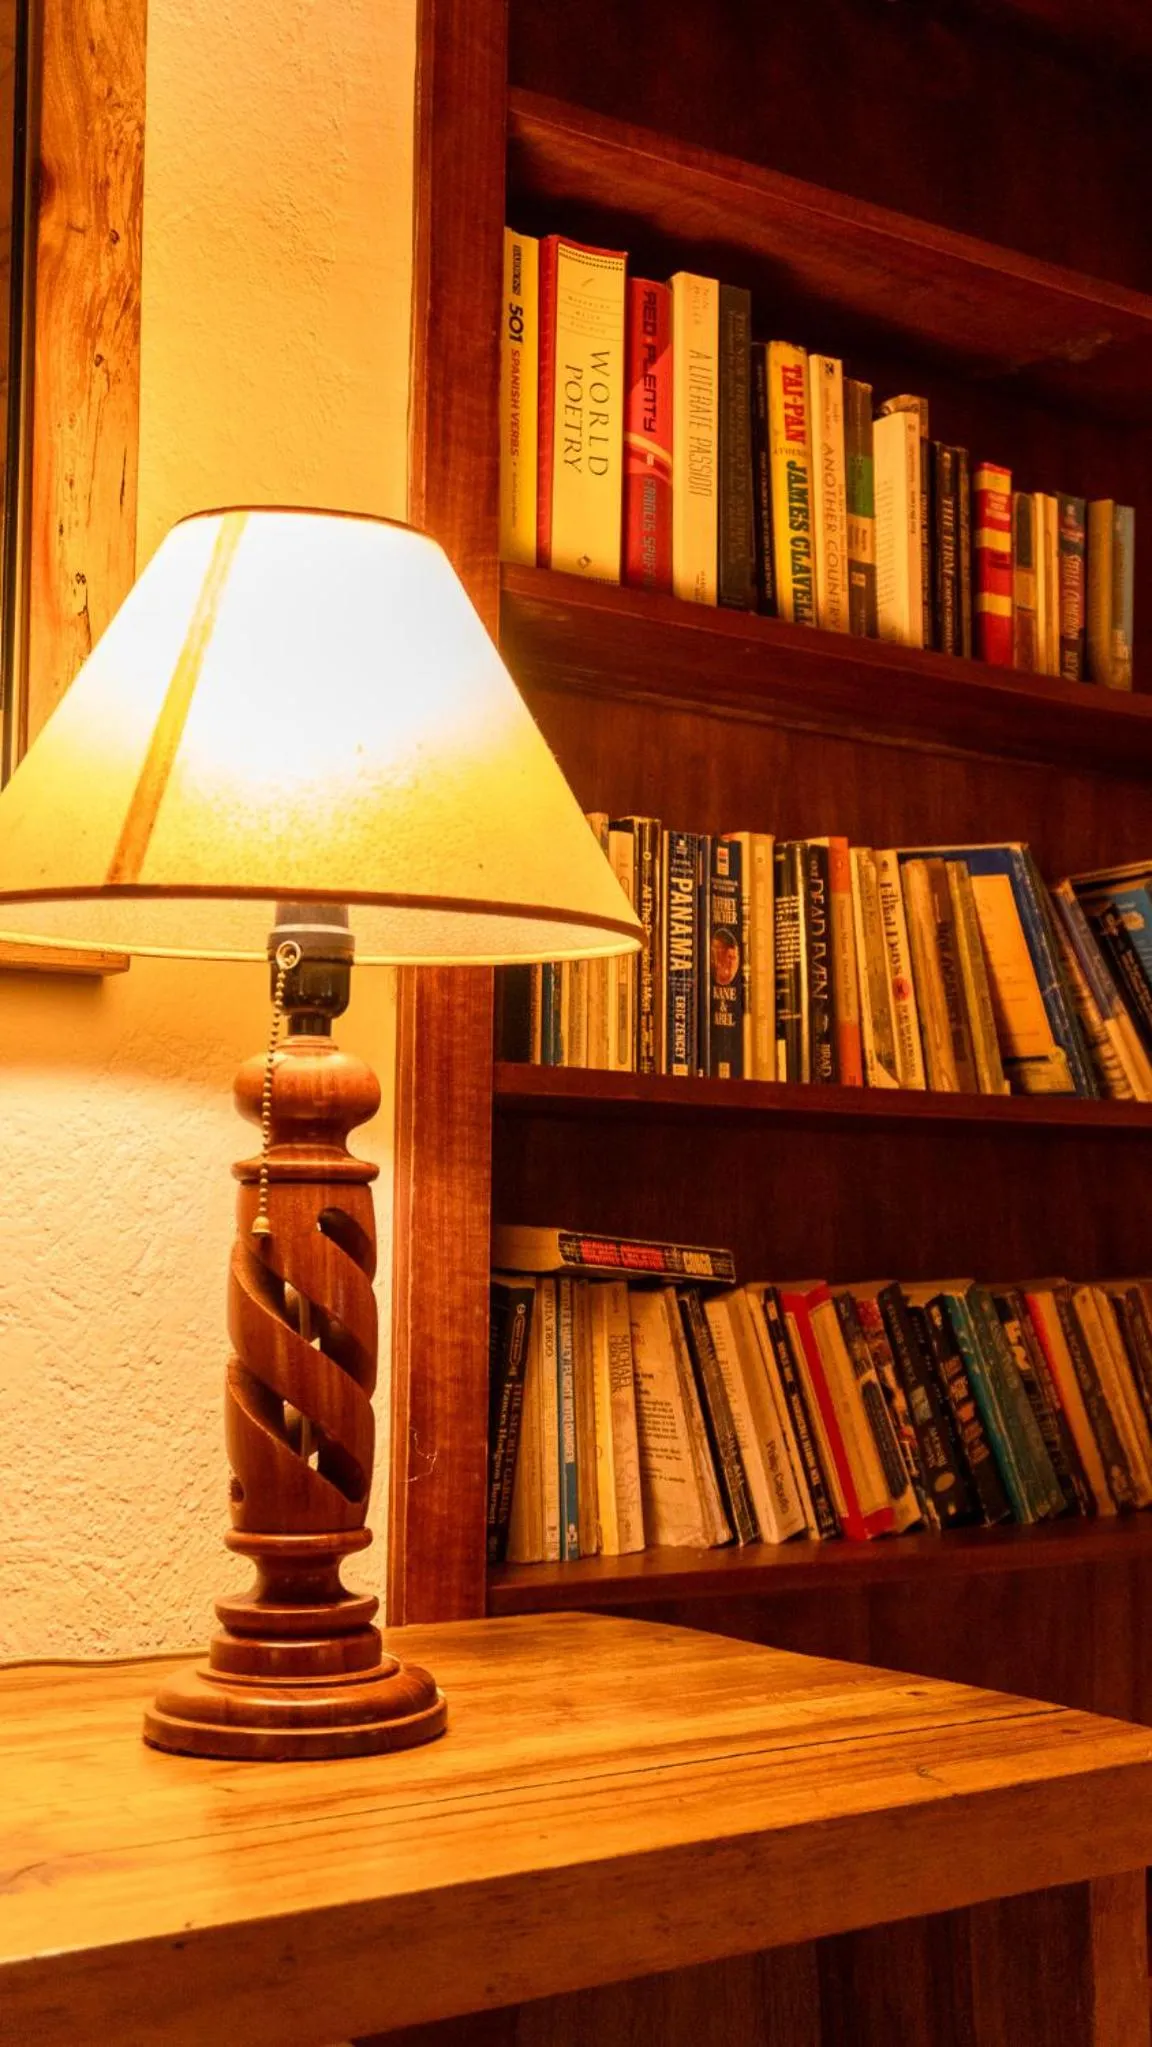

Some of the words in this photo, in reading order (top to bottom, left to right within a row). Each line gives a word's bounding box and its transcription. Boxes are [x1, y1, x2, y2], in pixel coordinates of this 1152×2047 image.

[508, 302, 524, 344] 501
[642, 290, 657, 338] RED
[510, 347, 521, 410] SPANISH
[688, 349, 713, 361] A
[588, 350, 611, 477] WORLD
[642, 342, 657, 433] PLENTY
[688, 364, 713, 432] LITERATE
[781, 364, 807, 446] TAI-PAN
[509, 413, 520, 456] VERBS
[563, 364, 584, 475] POETRY
[688, 436, 713, 498] PASSION
[786, 457, 811, 533] JAMES
[822, 442, 838, 533] ANOTHER
[670, 876, 693, 972] PANAMA
[810, 878, 825, 937] DEAD
[713, 986, 737, 1001] KANE
[811, 942, 828, 1000] EVEN
[674, 996, 687, 1019] ERIC
[674, 1021, 687, 1059] ZENCEY
[543, 1287, 554, 1321] VIDAL
[544, 1327, 554, 1358] GORE
[619, 1335, 632, 1388] MICHAEL
